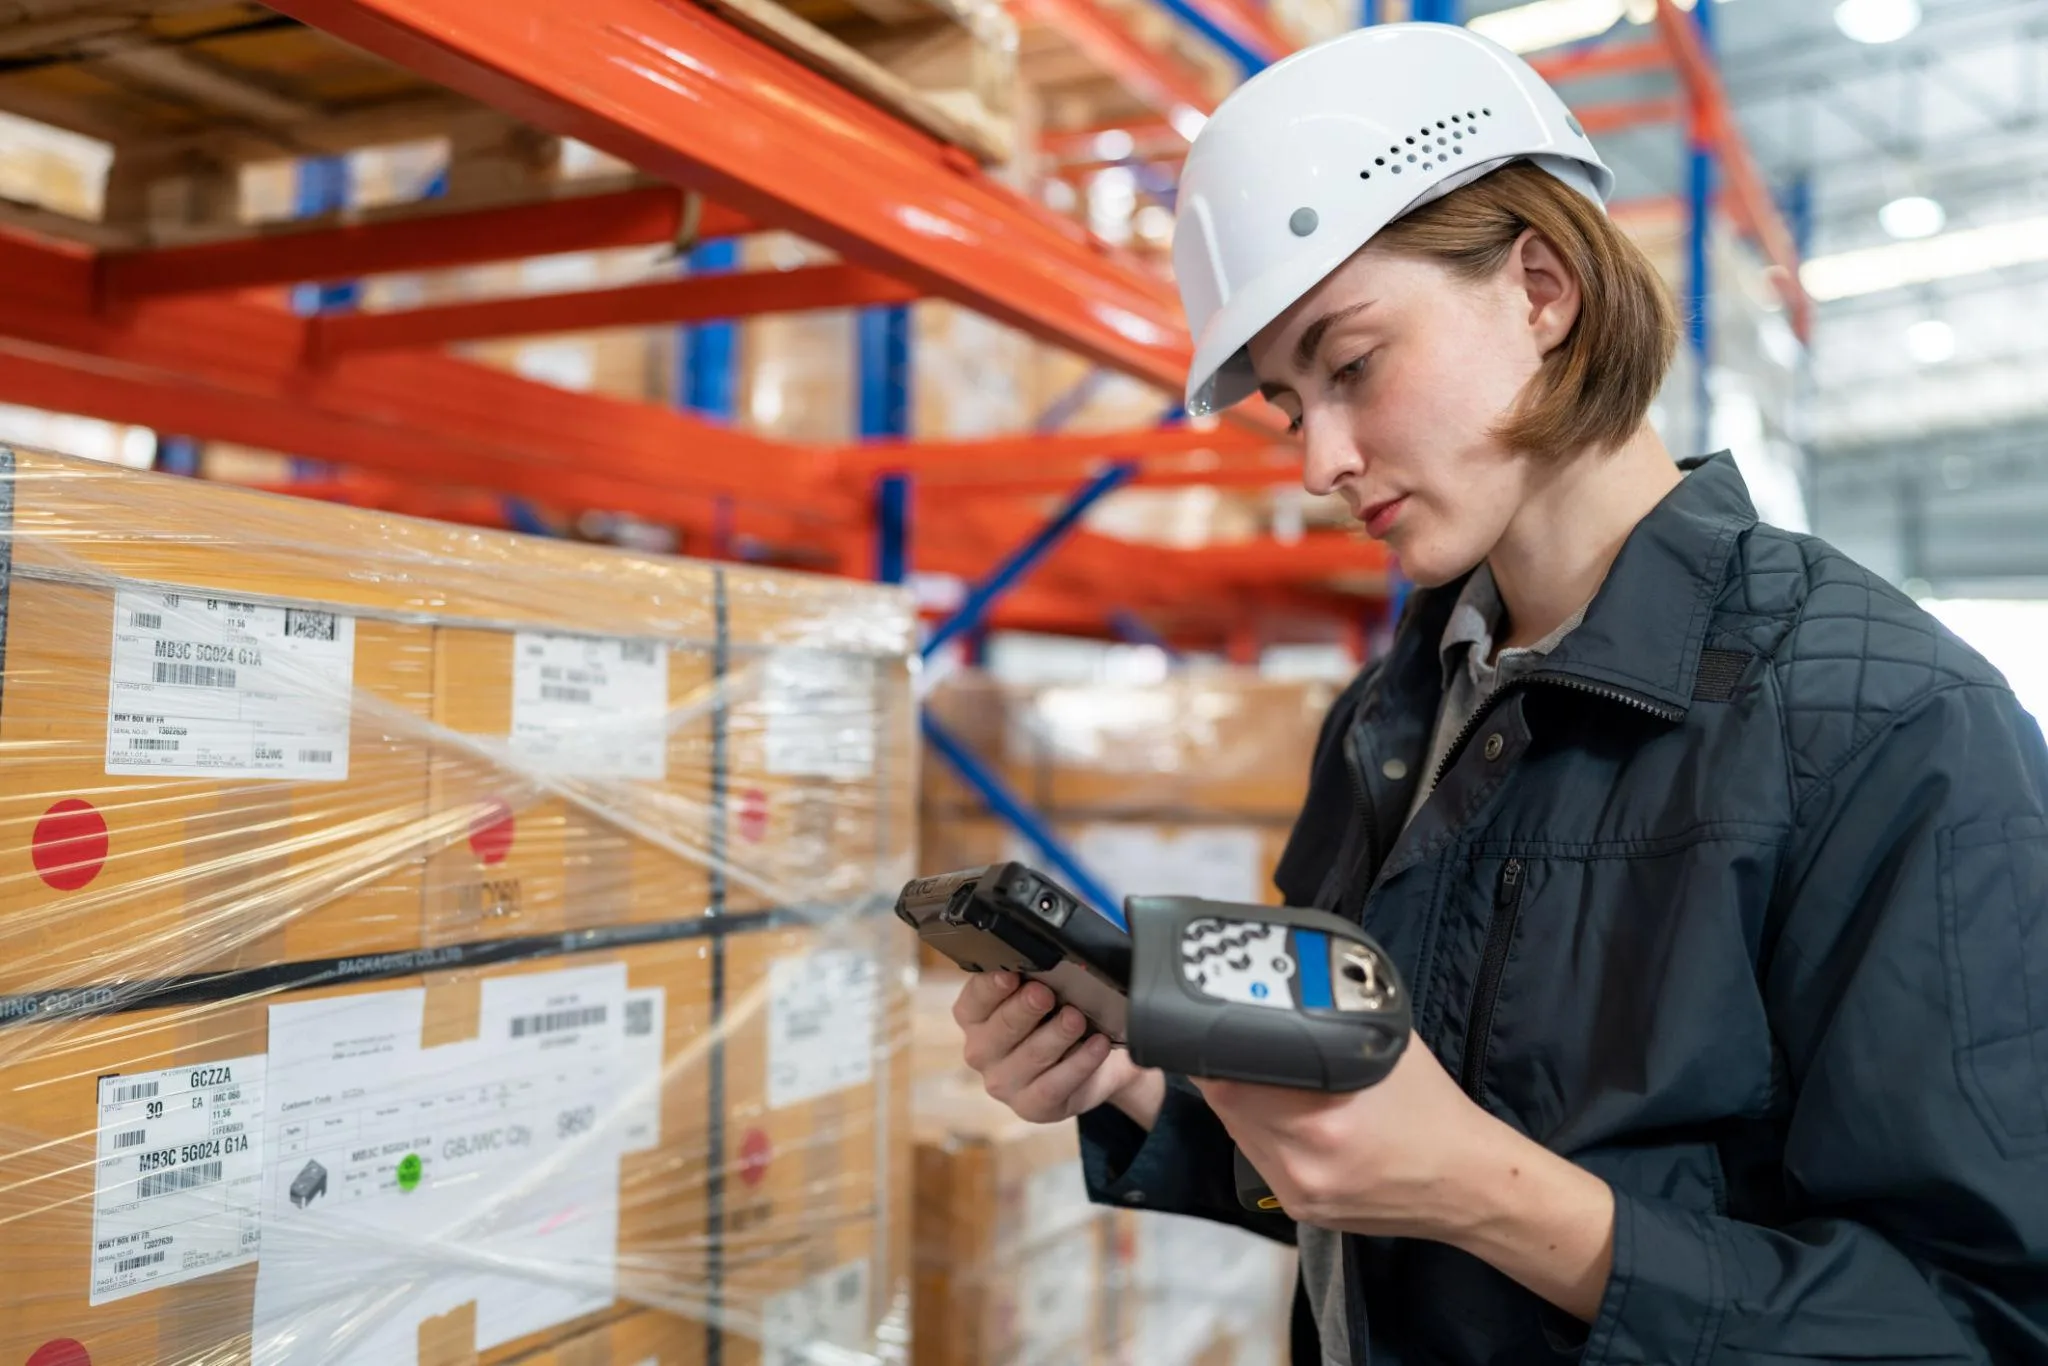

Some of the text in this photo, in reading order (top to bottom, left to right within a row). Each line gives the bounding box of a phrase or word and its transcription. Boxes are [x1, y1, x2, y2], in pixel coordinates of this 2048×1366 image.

[155, 640, 191, 660] MB3C
[239, 649, 262, 666] G1A
[191, 1067, 232, 1088] GCZZA
[146, 1097, 203, 1119] 30 EA
[139, 1149, 176, 1172] MB3C
[182, 1140, 220, 1163] 5G024
[225, 1135, 248, 1154] G1A
